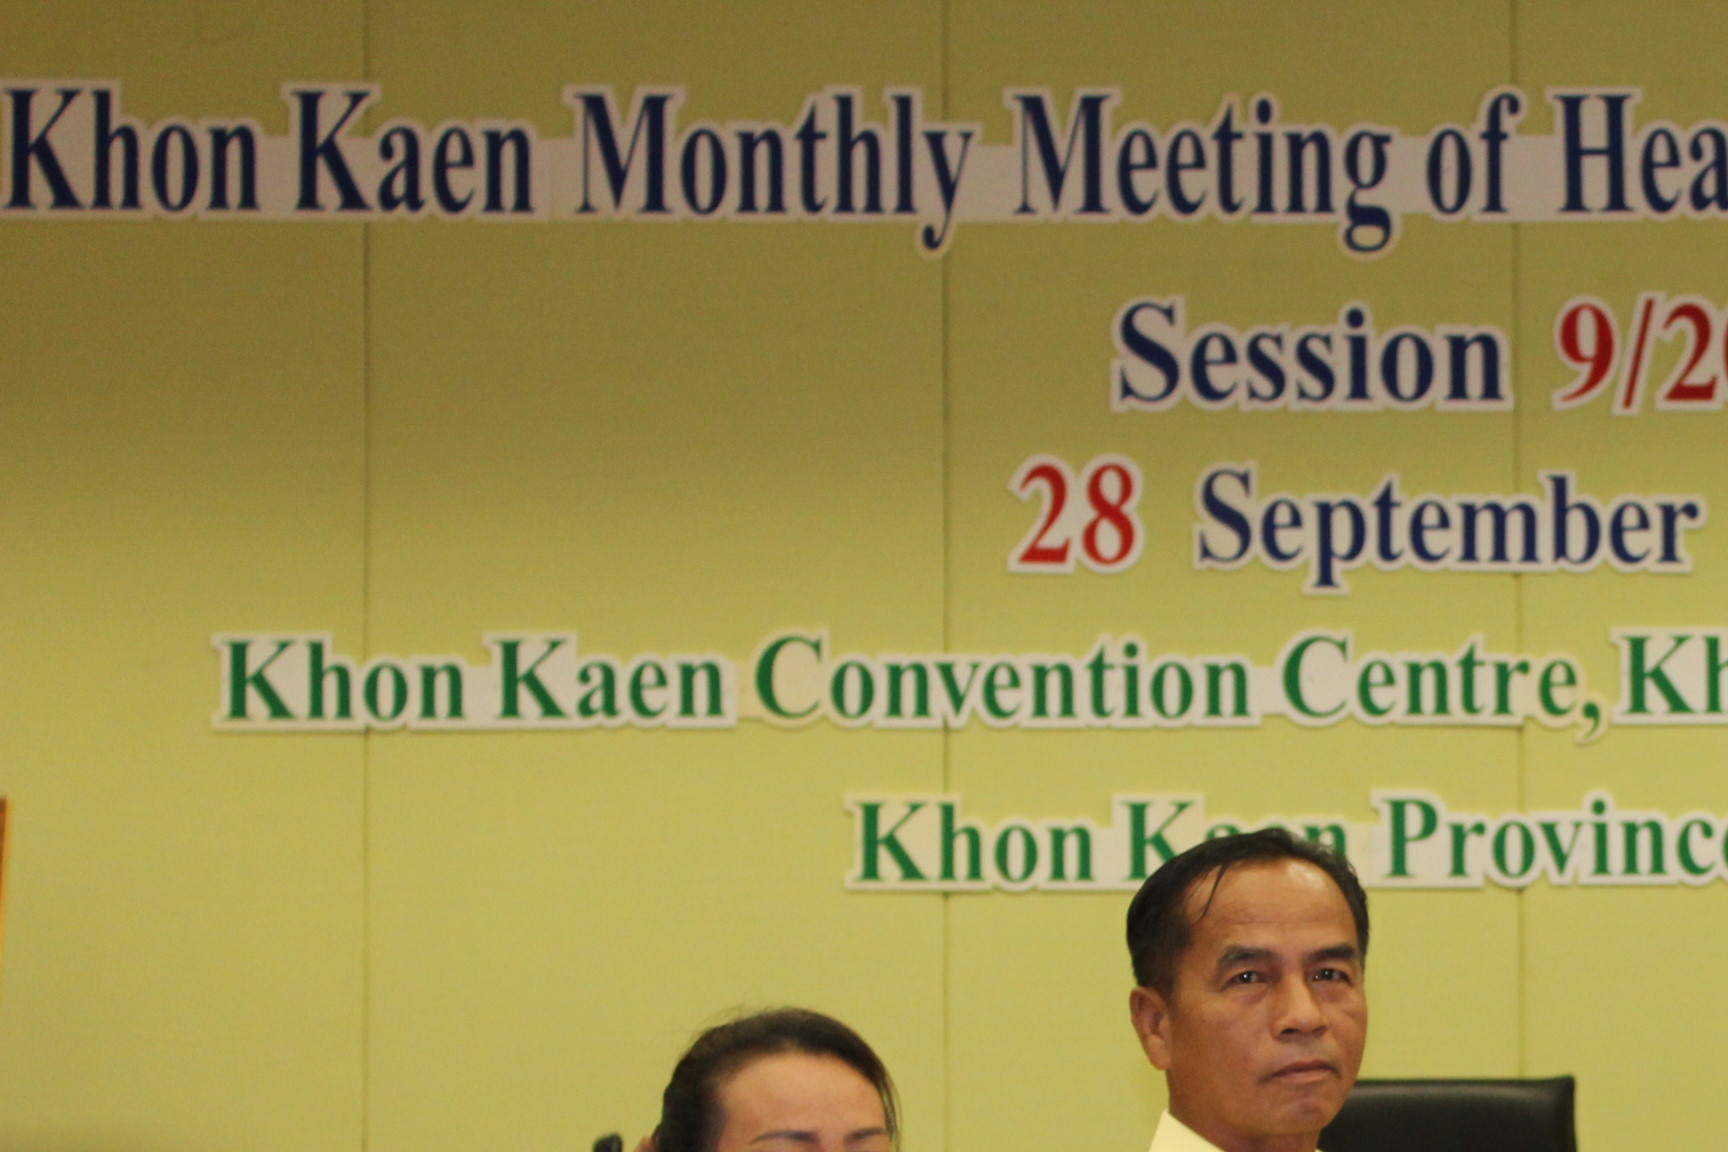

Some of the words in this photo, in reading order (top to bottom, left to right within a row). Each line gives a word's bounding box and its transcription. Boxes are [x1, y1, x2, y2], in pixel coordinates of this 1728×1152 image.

[4, 88, 259, 212] Khon
[292, 90, 534, 215] Kaen
[575, 92, 975, 251] Monthly
[1013, 93, 1394, 253] Meeting
[1426, 92, 1521, 215] of
[1118, 301, 1504, 402] Session
[1018, 462, 1138, 566] 28
[1198, 469, 1701, 588] September
[223, 637, 464, 721] Khon
[494, 636, 724, 721] Kaen
[753, 634, 1252, 721] Convention
[1281, 635, 1603, 736] Centre,
[854, 801, 1094, 882] Khon
